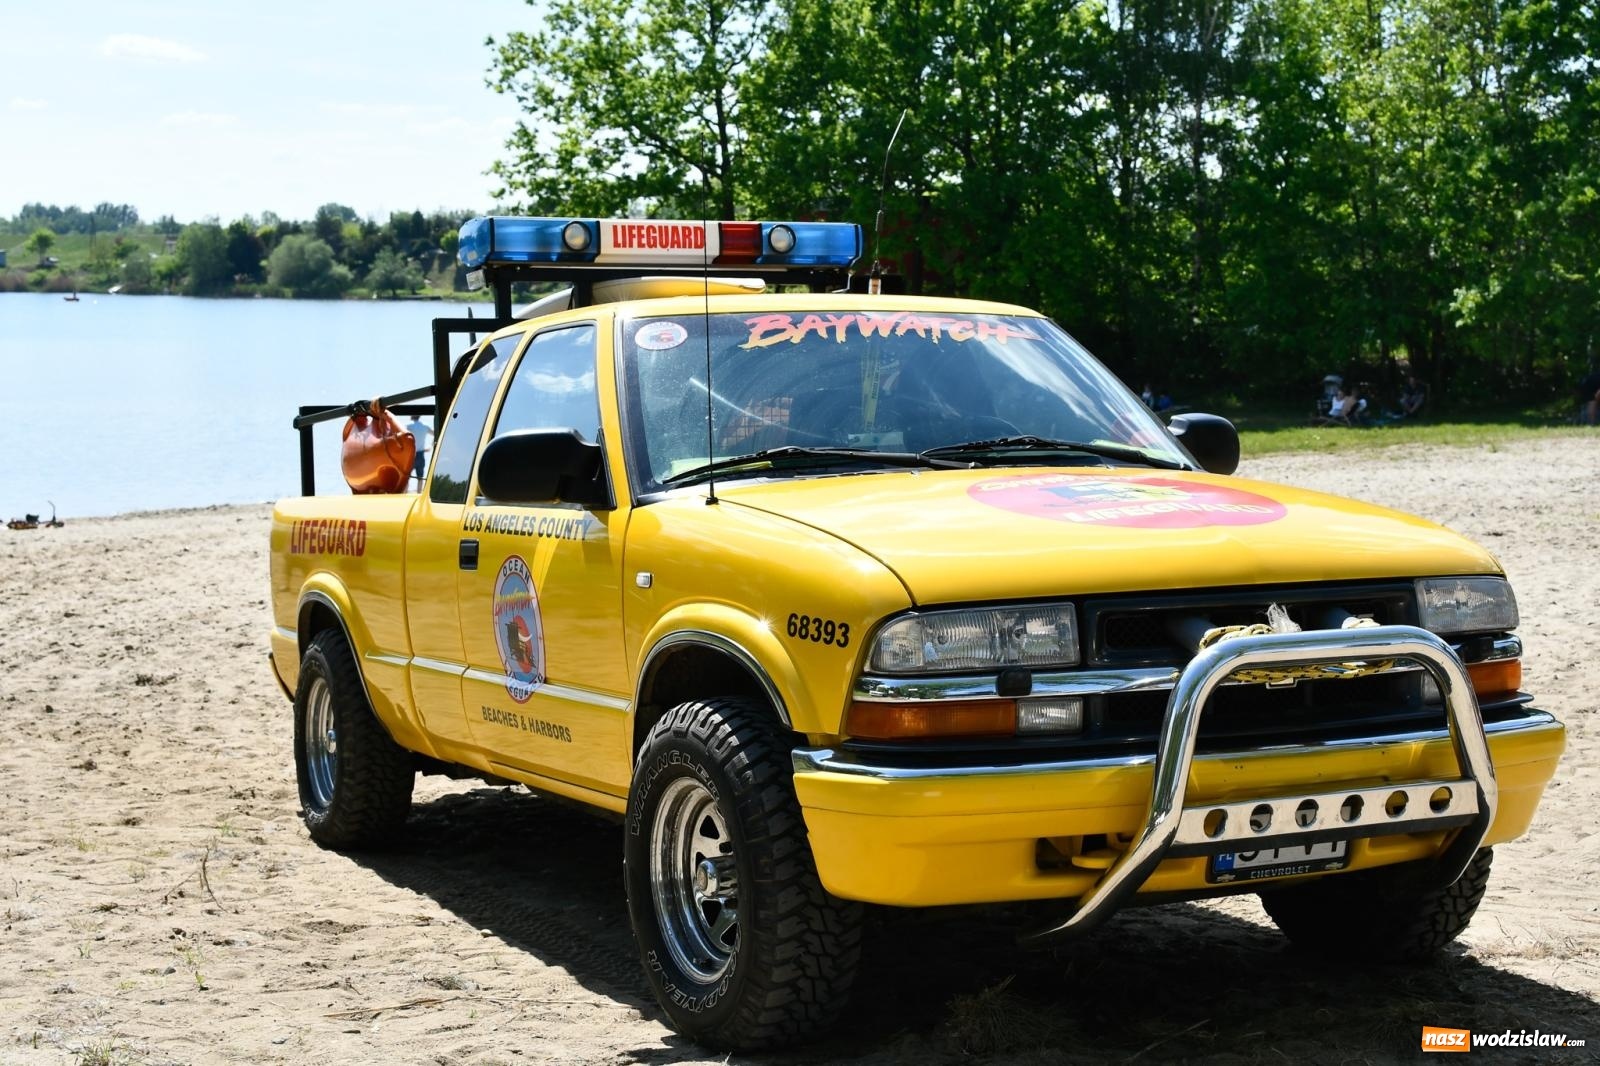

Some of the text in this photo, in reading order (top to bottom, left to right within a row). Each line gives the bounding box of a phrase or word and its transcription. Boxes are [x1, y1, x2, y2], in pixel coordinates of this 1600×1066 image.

[612, 224, 705, 249] LIFEGUARD
[738, 312, 1042, 349] BAYWATCH
[463, 512, 592, 540] LOS ANGELES COUNTY
[1063, 502, 1275, 523] LIFEGUARD
[291, 519, 367, 557] LIFEGUARD
[502, 559, 530, 585] OCEAN
[787, 612, 850, 648] 68393
[482, 705, 572, 743] BEACHES & HARBORS
[631, 750, 720, 836] WRANGLER
[1250, 865, 1311, 879] CHEVROLET
